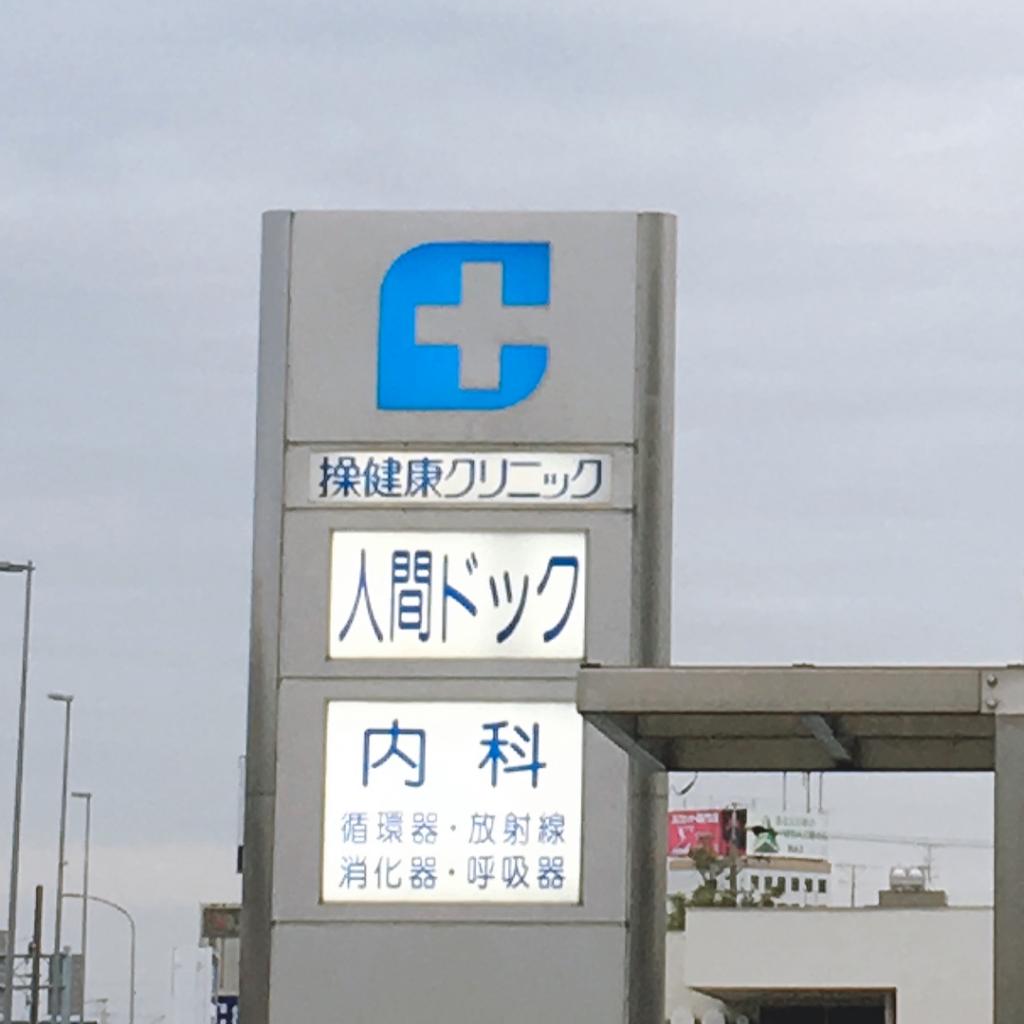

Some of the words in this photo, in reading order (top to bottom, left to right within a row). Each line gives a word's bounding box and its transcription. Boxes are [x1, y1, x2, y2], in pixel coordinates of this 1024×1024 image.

[319, 456, 602, 498] 操健康クリニック
[338, 548, 579, 643] 人間ドック
[341, 811, 566, 845] 循環器・放射線
[339, 855, 566, 890] 消化器・呼吸器
